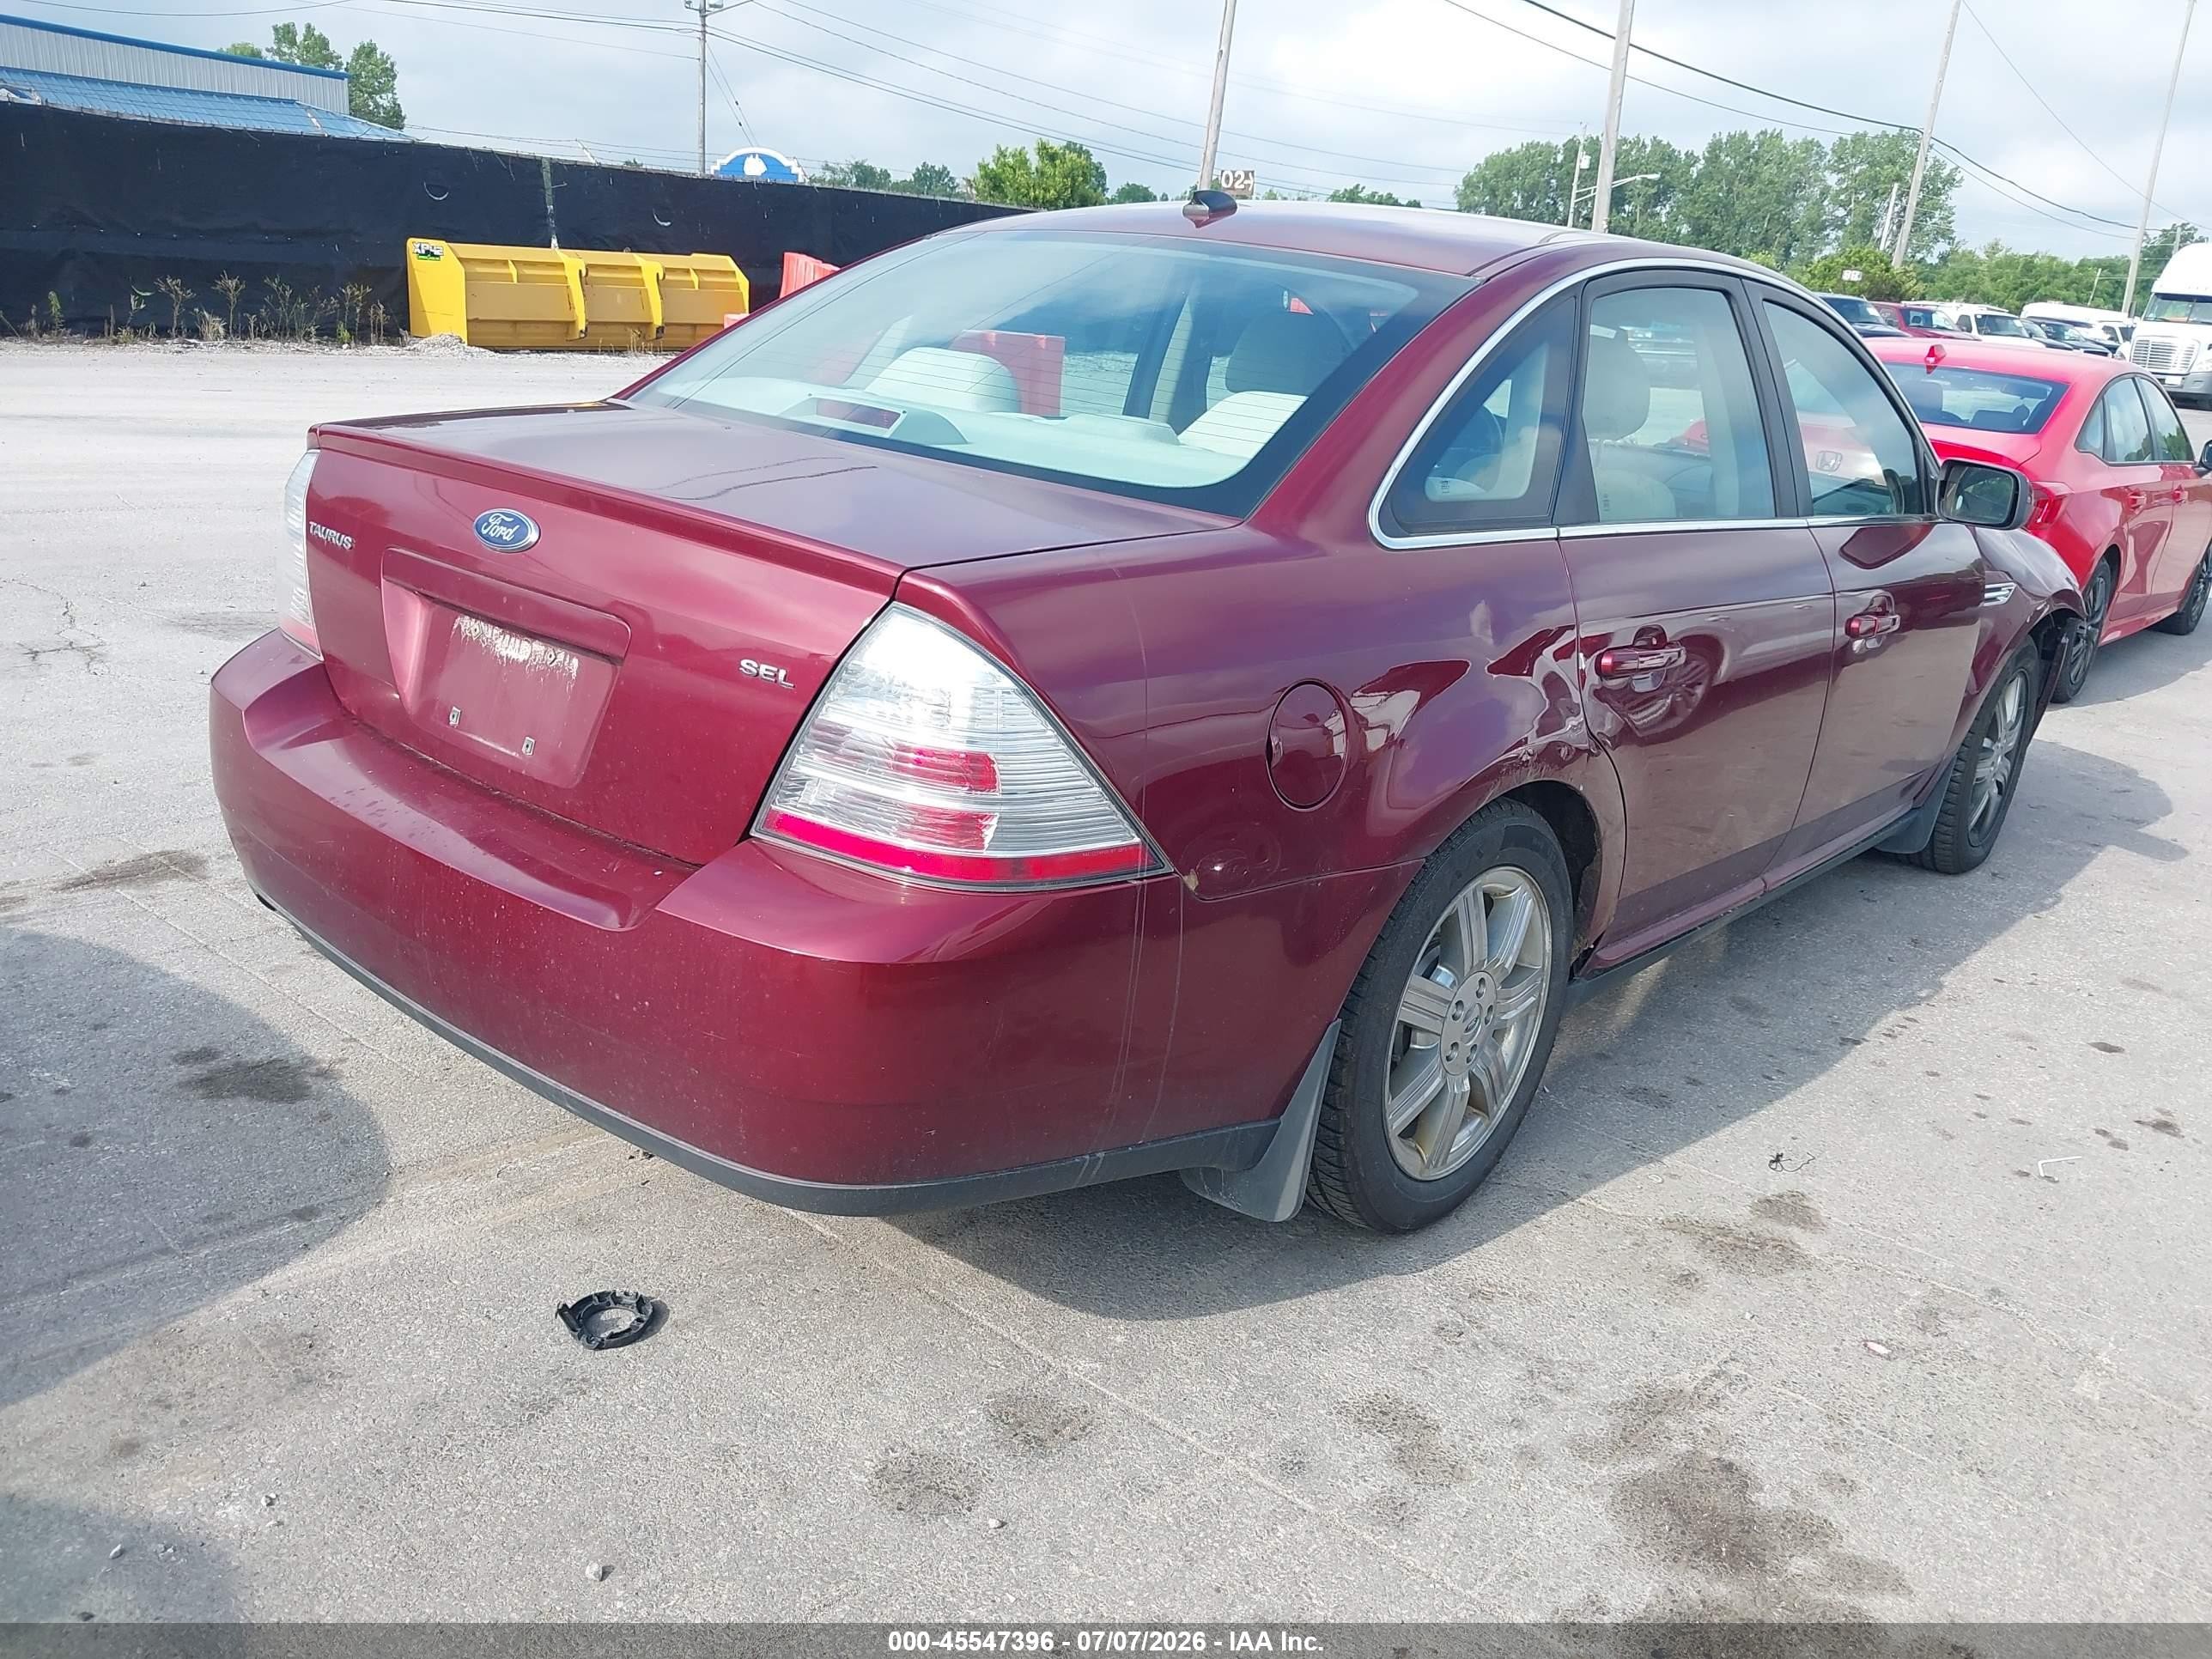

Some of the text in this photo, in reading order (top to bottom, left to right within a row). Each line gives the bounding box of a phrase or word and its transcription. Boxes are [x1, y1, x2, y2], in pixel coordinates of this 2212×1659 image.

[309, 520, 354, 550] TAURUS
[481, 513, 520, 542] Ford
[738, 659, 795, 690] SEL
